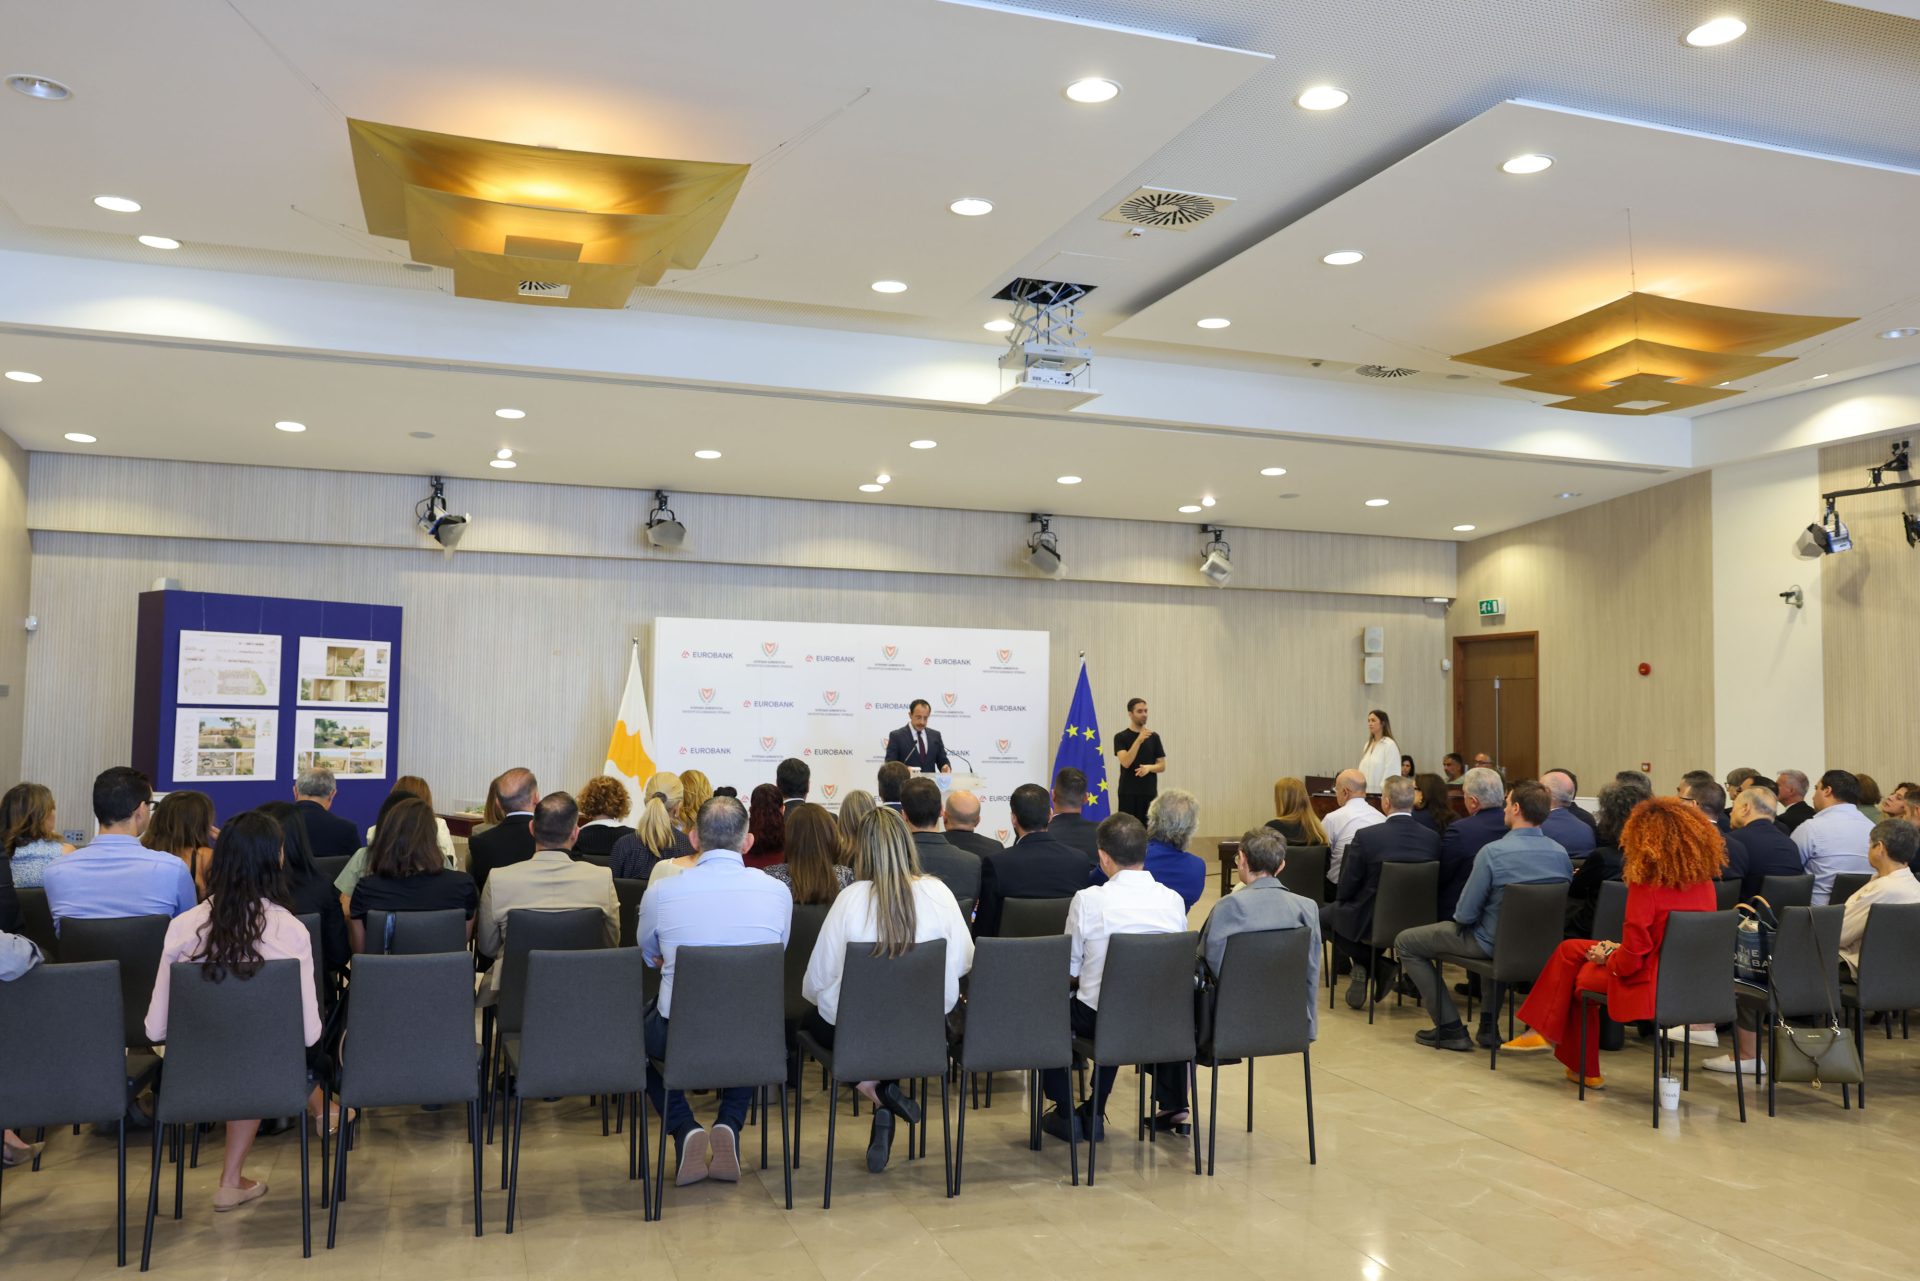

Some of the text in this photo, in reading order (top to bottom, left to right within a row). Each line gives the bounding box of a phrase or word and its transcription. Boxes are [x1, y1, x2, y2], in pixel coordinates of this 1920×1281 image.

[692, 651, 733, 659] EUROBANK
[815, 655, 855, 663] EUROBANK
[933, 658, 971, 666] EUROBANK
[753, 700, 794, 708] EUROBANK
[875, 702, 910, 710] EUROBAN
[989, 704, 1027, 712] EUROBANK
[690, 747, 731, 755] EUROBANK
[813, 748, 853, 756] EUROBANK
[989, 794, 1011, 802] EUROB
[1738, 944, 1760, 957] THE
